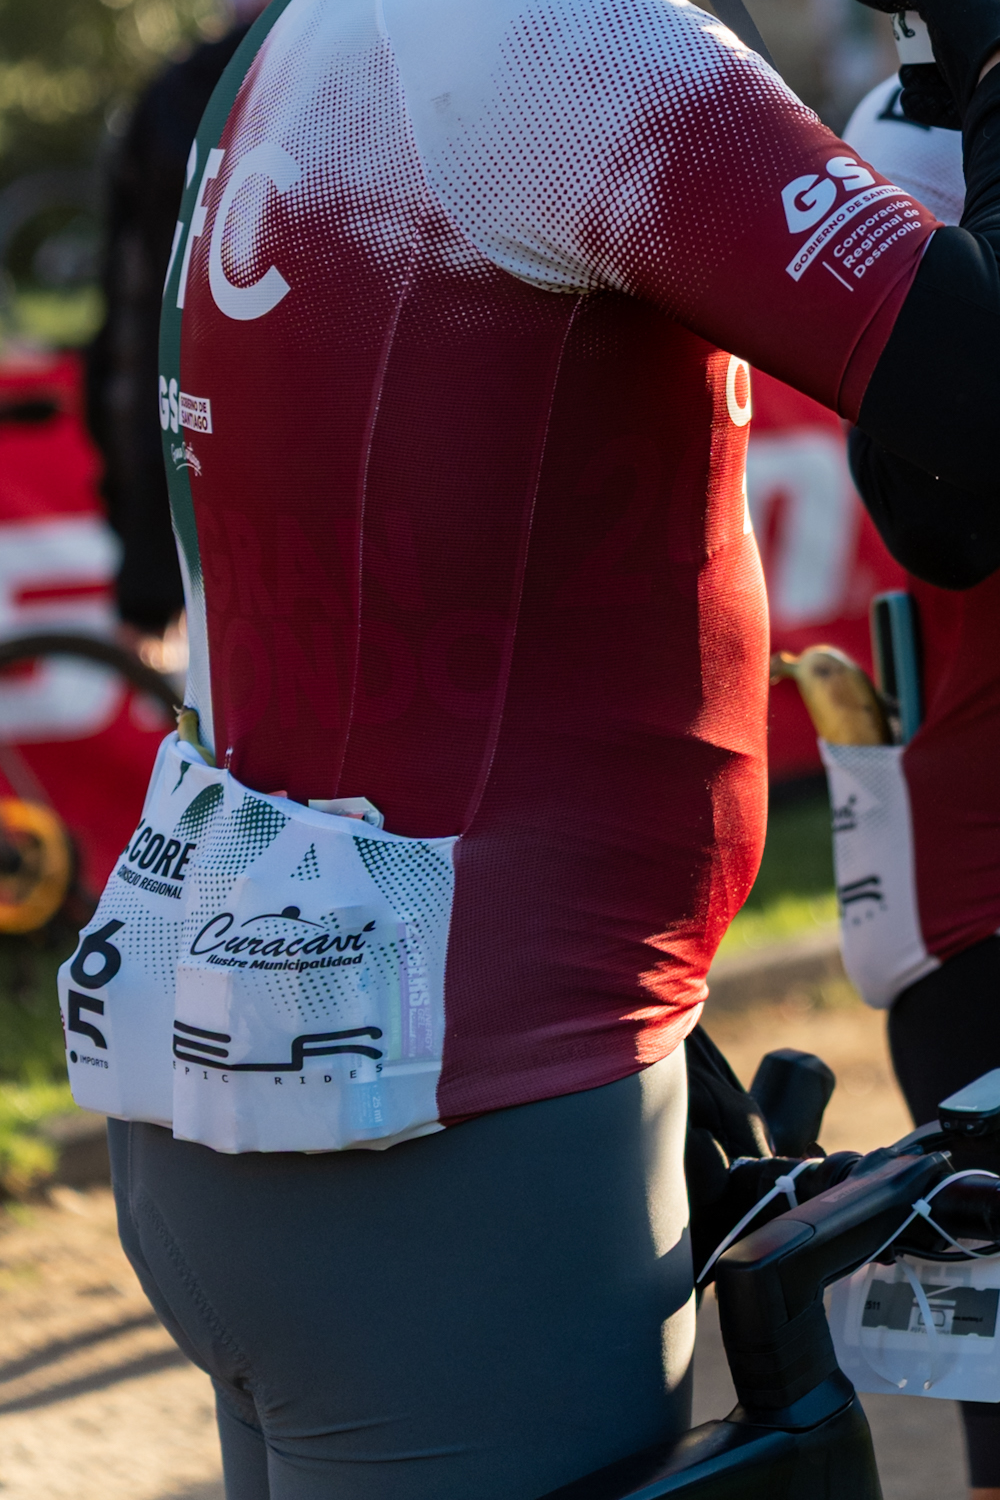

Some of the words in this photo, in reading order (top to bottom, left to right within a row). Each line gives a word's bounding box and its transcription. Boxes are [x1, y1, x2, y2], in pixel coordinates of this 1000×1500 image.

[780, 155, 876, 234] GS
[793, 213, 846, 273] GOBIERNO
[846, 199, 863, 214] DE
[833, 199, 913, 258] Corporación
[842, 214, 903, 269] Regional
[903, 208, 920, 218] de
[852, 219, 922, 279] Desarrollo
[128, 826, 197, 881] CORE
[140, 874, 184, 900] REGIONAL
[189, 911, 376, 958] Curacaví
[206, 953, 249, 969] Ilustre
[79, 1054, 110, 1070] IMPORTS
[274, 1063, 384, 1086] RIDES
